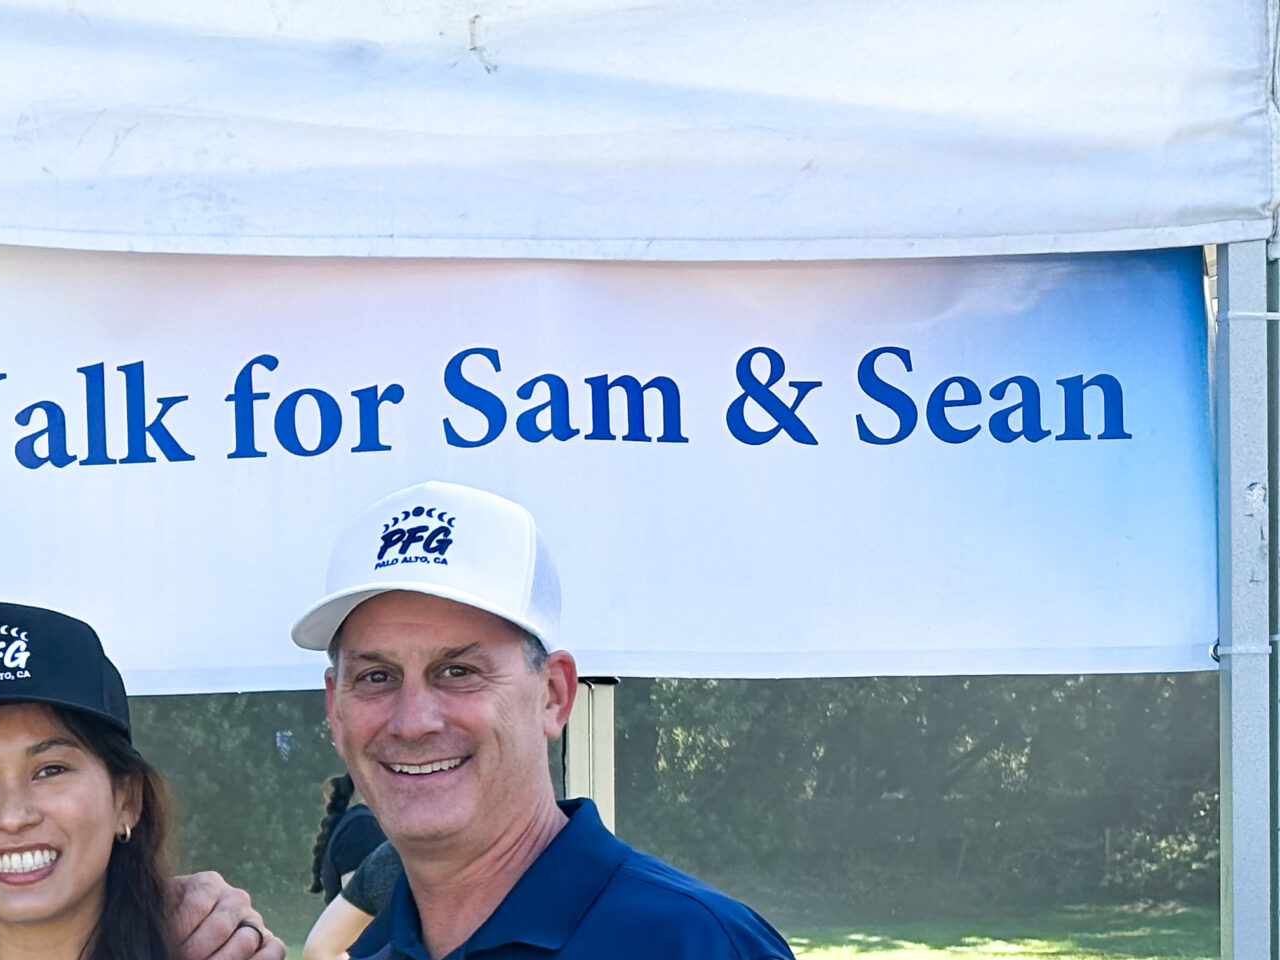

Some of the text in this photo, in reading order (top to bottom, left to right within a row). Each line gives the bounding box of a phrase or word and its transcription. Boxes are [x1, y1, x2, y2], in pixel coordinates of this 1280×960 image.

[224, 354, 405, 459] for
[442, 347, 689, 449] Sam
[725, 346, 823, 446] &
[855, 346, 1133, 445] Sean
[377, 525, 454, 561] PFG
[374, 556, 448, 570] PALO ALTO, CA
[16, 670, 31, 678] CA
